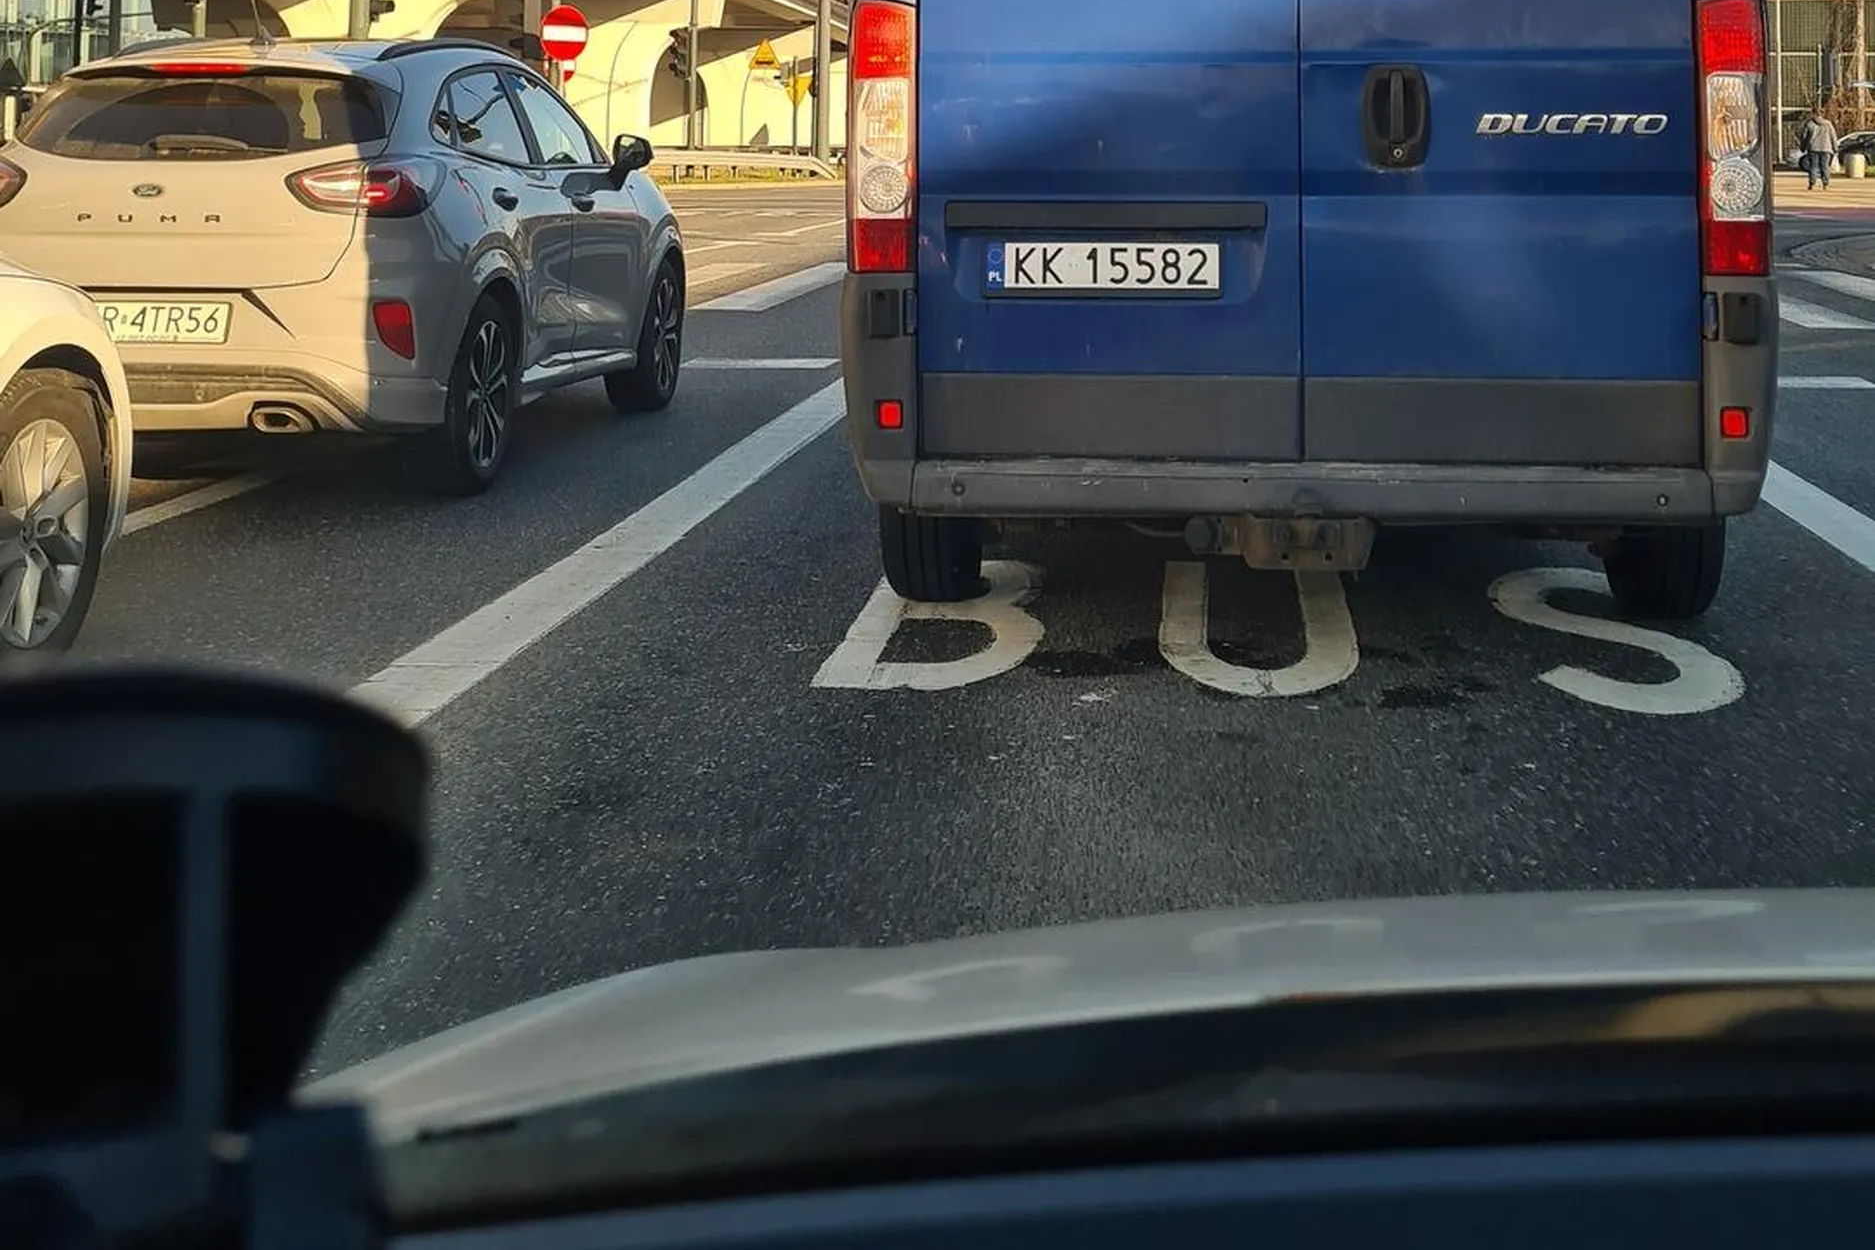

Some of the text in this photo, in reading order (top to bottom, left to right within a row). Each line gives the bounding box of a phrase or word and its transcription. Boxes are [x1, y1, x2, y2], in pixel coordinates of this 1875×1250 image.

[1476, 113, 1669, 135] DUCATO
[77, 212, 221, 223] PUMA
[988, 270, 1003, 282] PL
[1014, 247, 1209, 286] KK 15582
[98, 306, 220, 334] R 4TR56
[808, 559, 1748, 717] BUS
